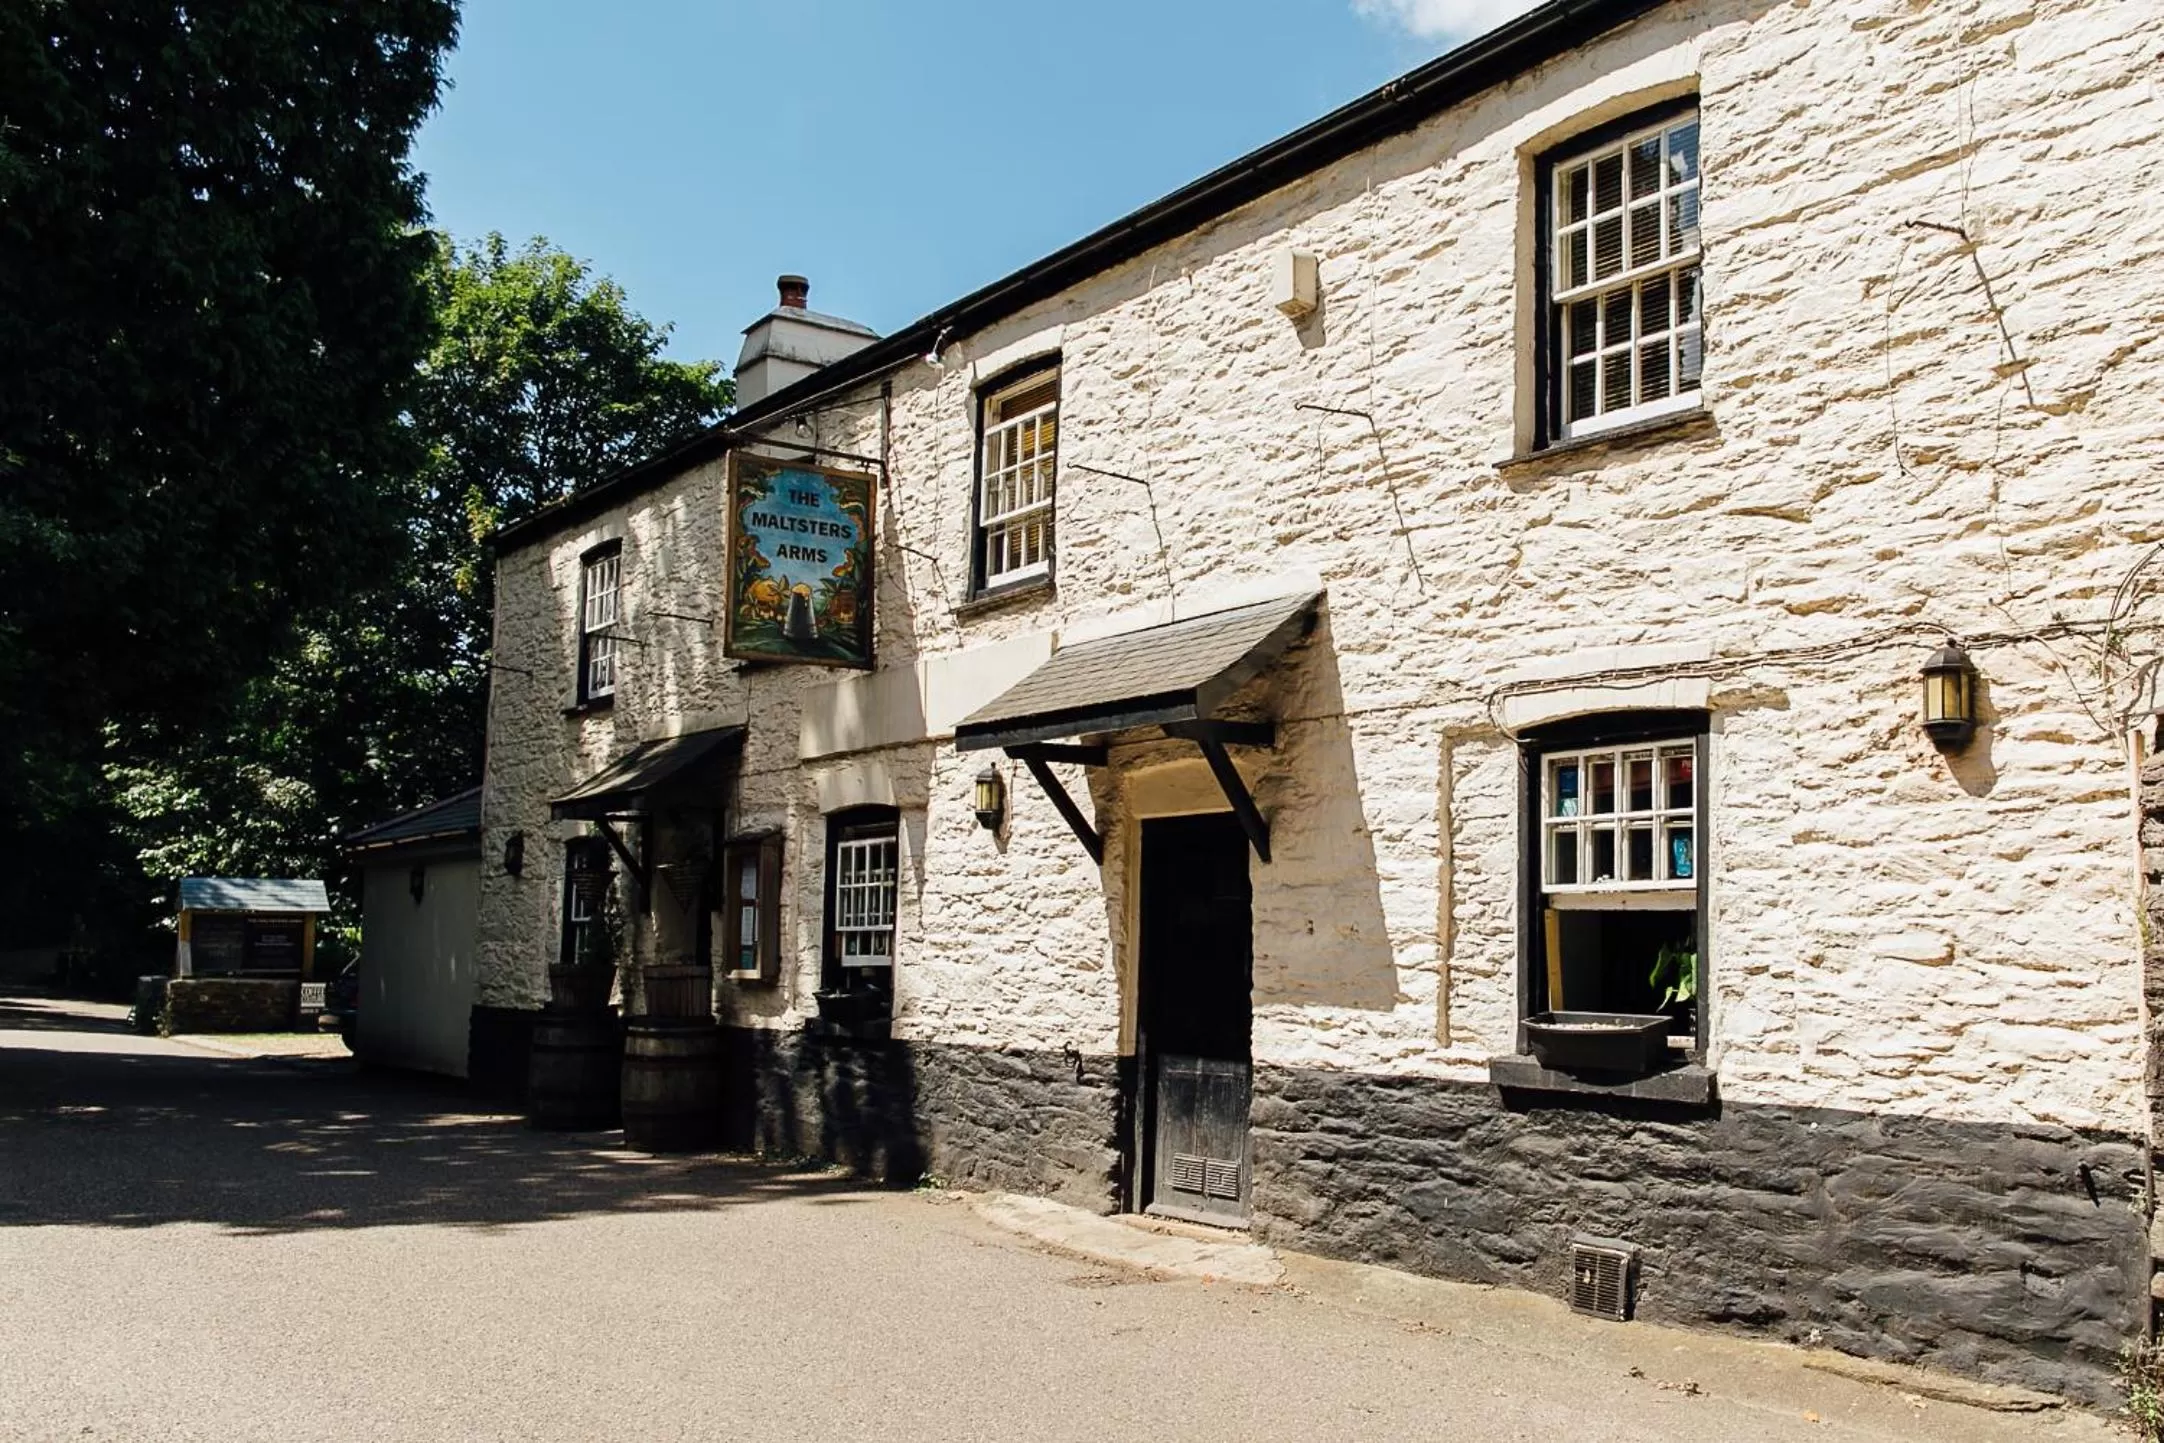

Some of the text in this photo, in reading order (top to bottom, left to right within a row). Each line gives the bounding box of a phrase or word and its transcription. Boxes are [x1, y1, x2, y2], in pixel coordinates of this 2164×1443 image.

[789, 489, 820, 508] THE
[752, 512, 852, 539] MALTSTERS
[776, 544, 828, 564] ARMS
